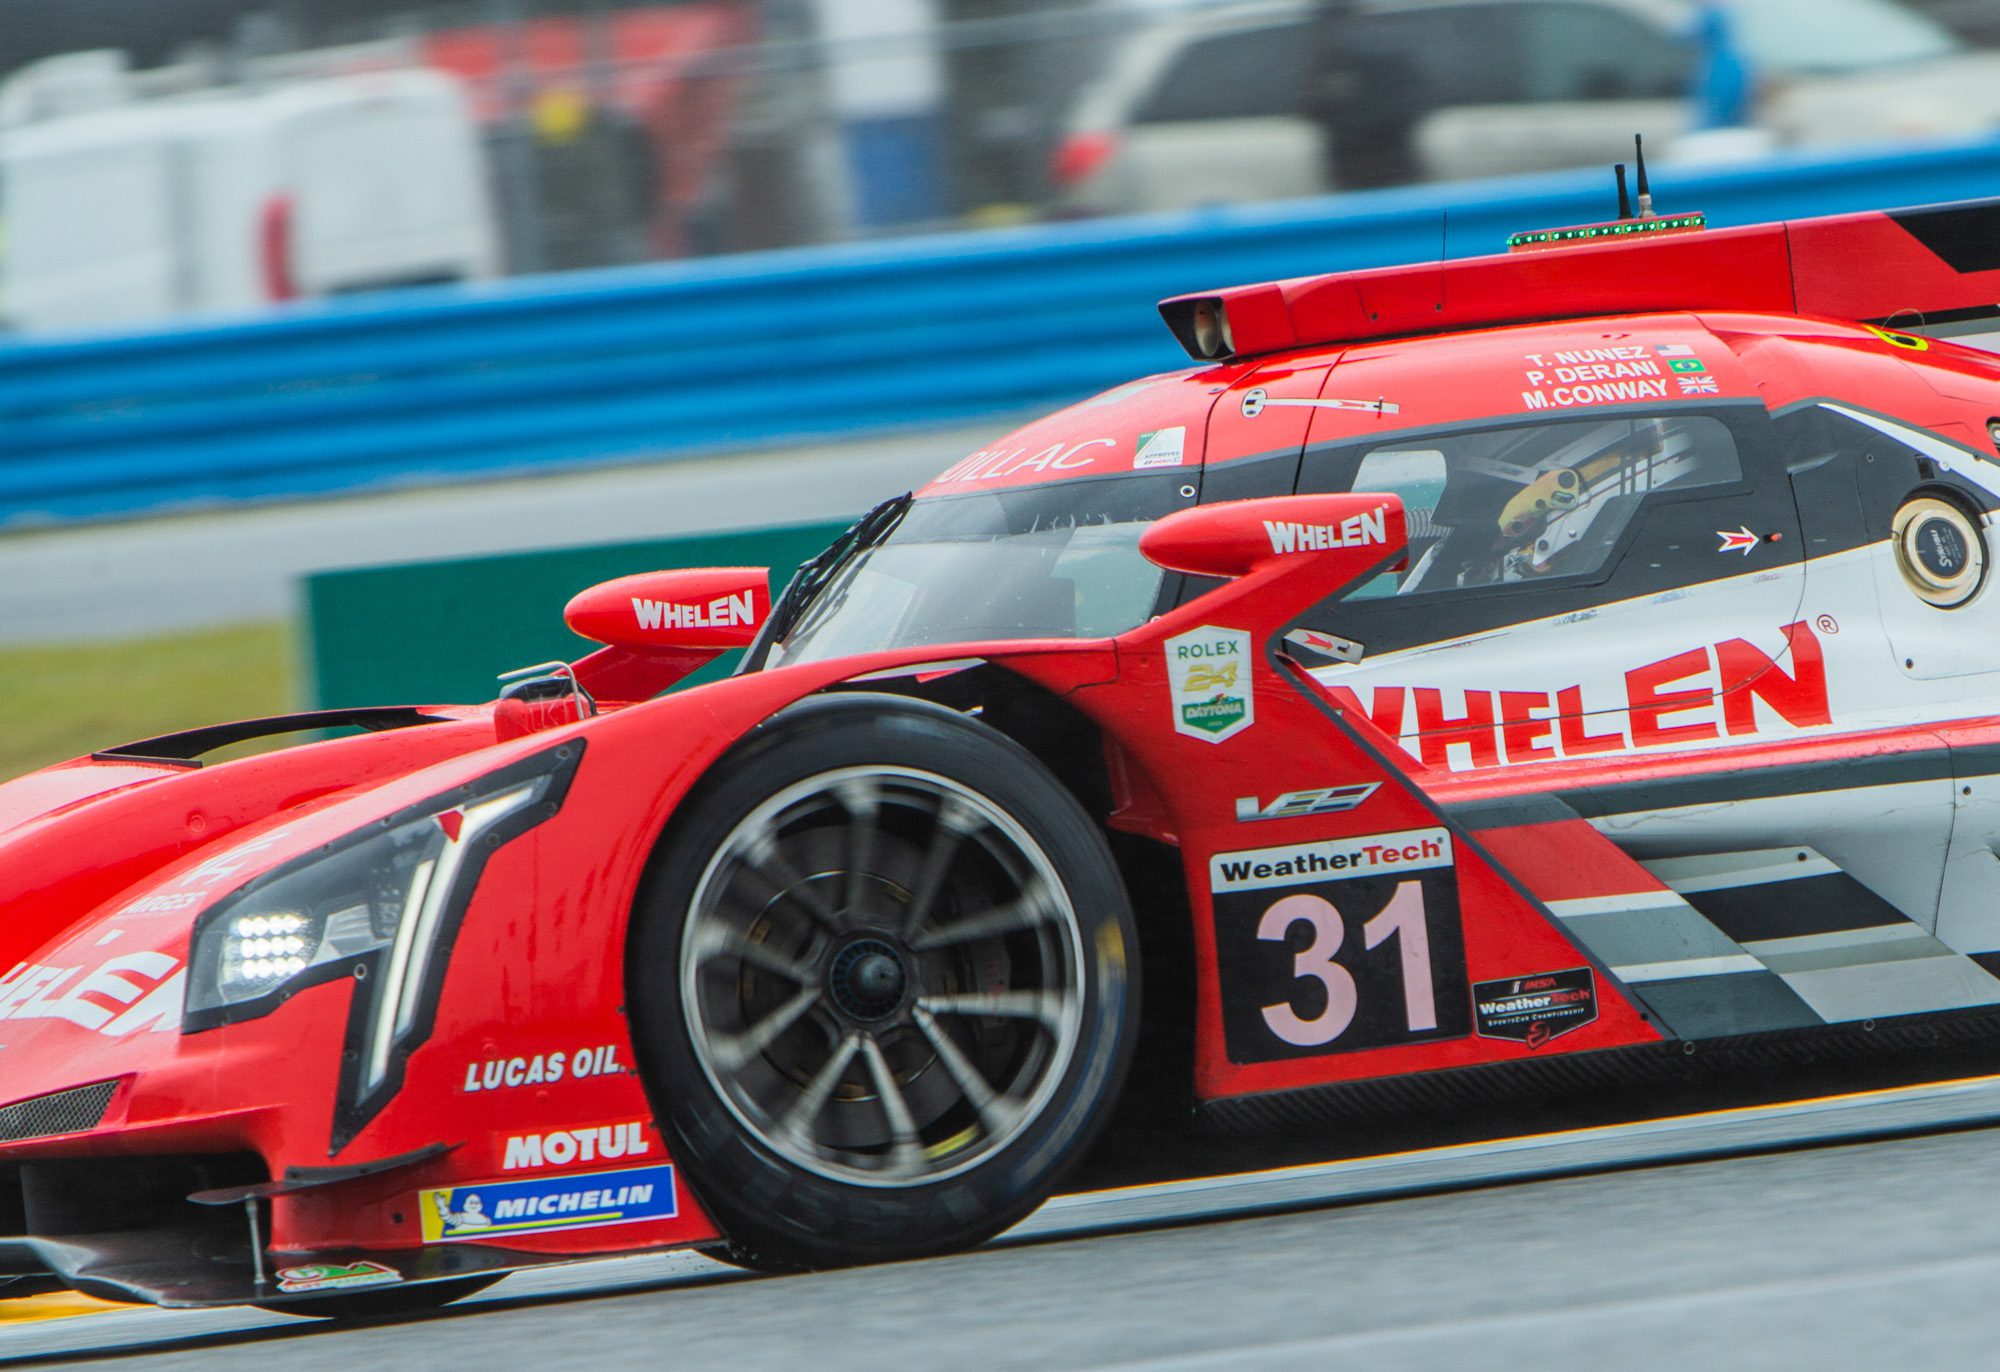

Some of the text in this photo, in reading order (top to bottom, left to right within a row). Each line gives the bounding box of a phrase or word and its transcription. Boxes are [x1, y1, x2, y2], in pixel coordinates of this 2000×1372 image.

[1524, 346, 1651, 369] T. NUNEZ
[1525, 361, 1661, 387] P. DERANI
[1521, 379, 1667, 410] M.CONWAY
[1262, 508, 1387, 555] WHELEN
[631, 589, 754, 630] WHELEN
[1177, 640, 1239, 660] ROLEX
[1183, 661, 1239, 693] 24
[1185, 702, 1242, 719] DAYTONA
[1256, 879, 1438, 1047] 31
[464, 1052, 566, 1092] LUCAS
[503, 1122, 649, 1171] MOTUL
[494, 1184, 654, 1219] MICHELIN
